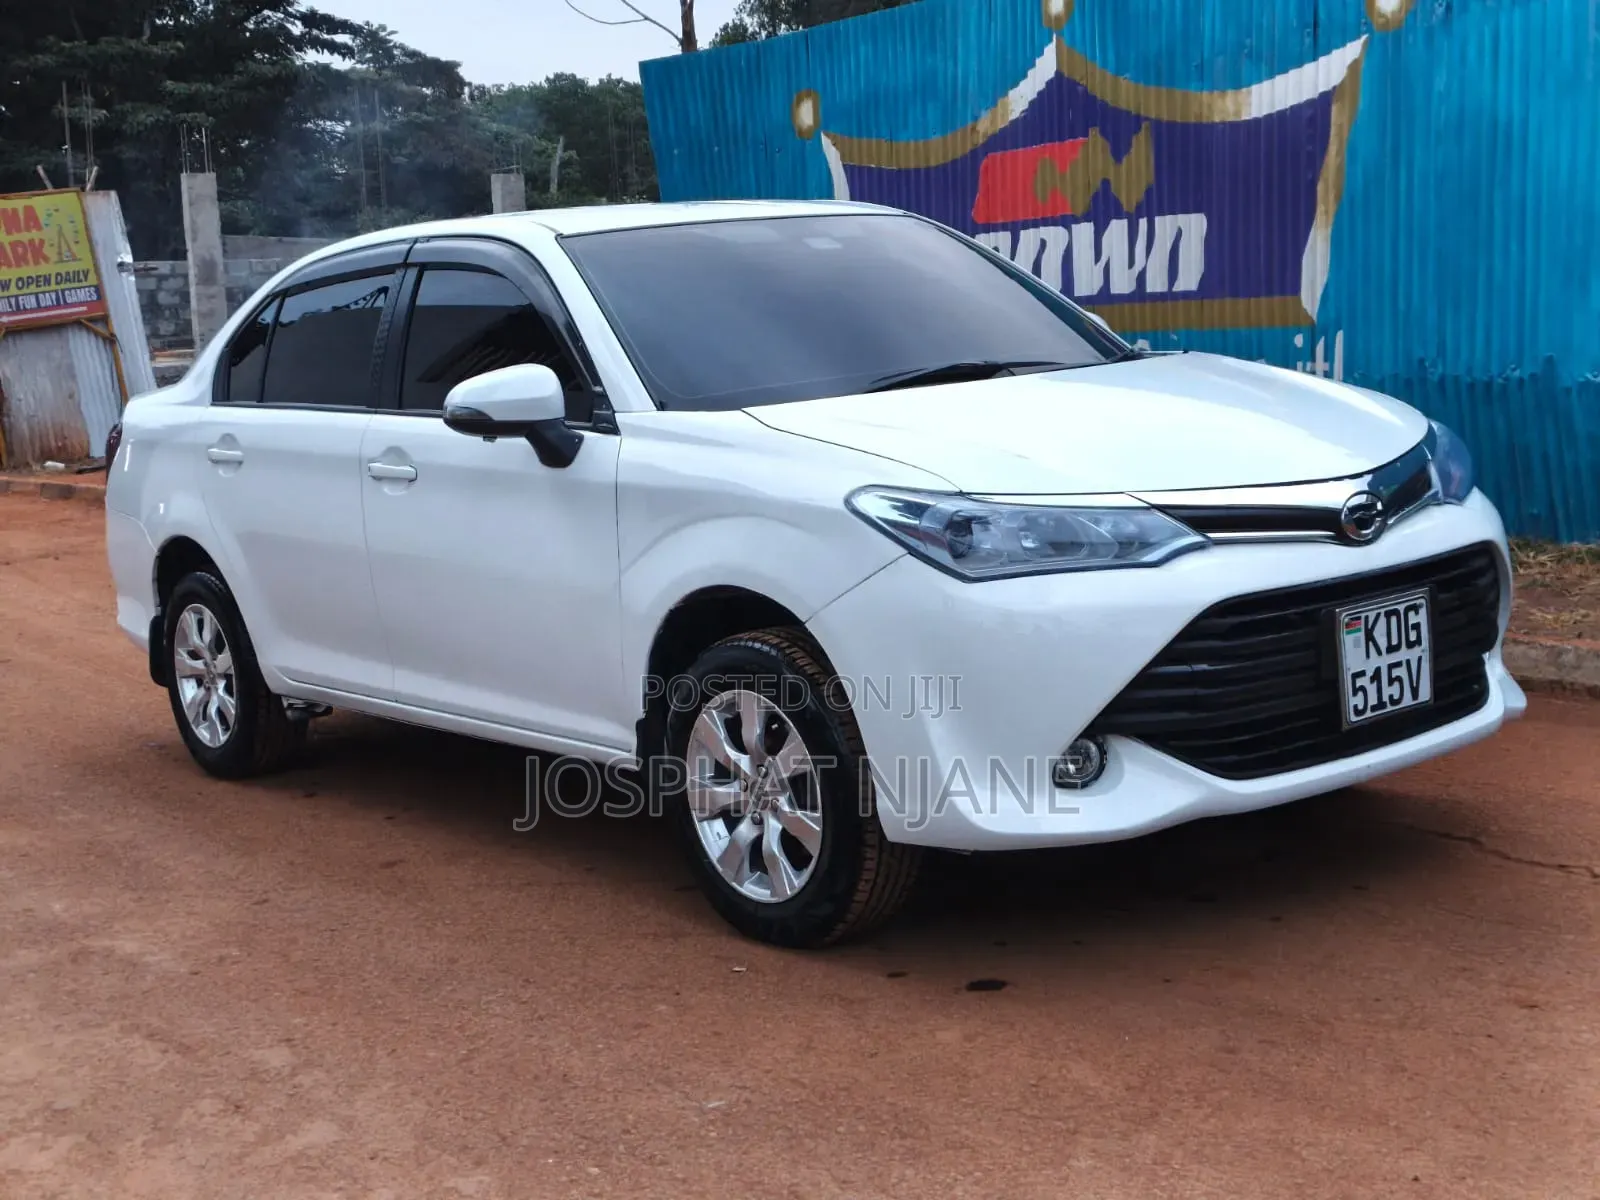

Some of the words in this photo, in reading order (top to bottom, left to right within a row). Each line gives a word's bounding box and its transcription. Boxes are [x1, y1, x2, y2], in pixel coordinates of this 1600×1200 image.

[15, 273, 52, 291] OPEN
[54, 269, 90, 286] DAILY
[18, 294, 38, 311] FUN
[38, 291, 57, 307] DAY
[64, 287, 98, 304] GAMES
[1363, 602, 1423, 660] KDG
[1351, 655, 1423, 718] 515V
